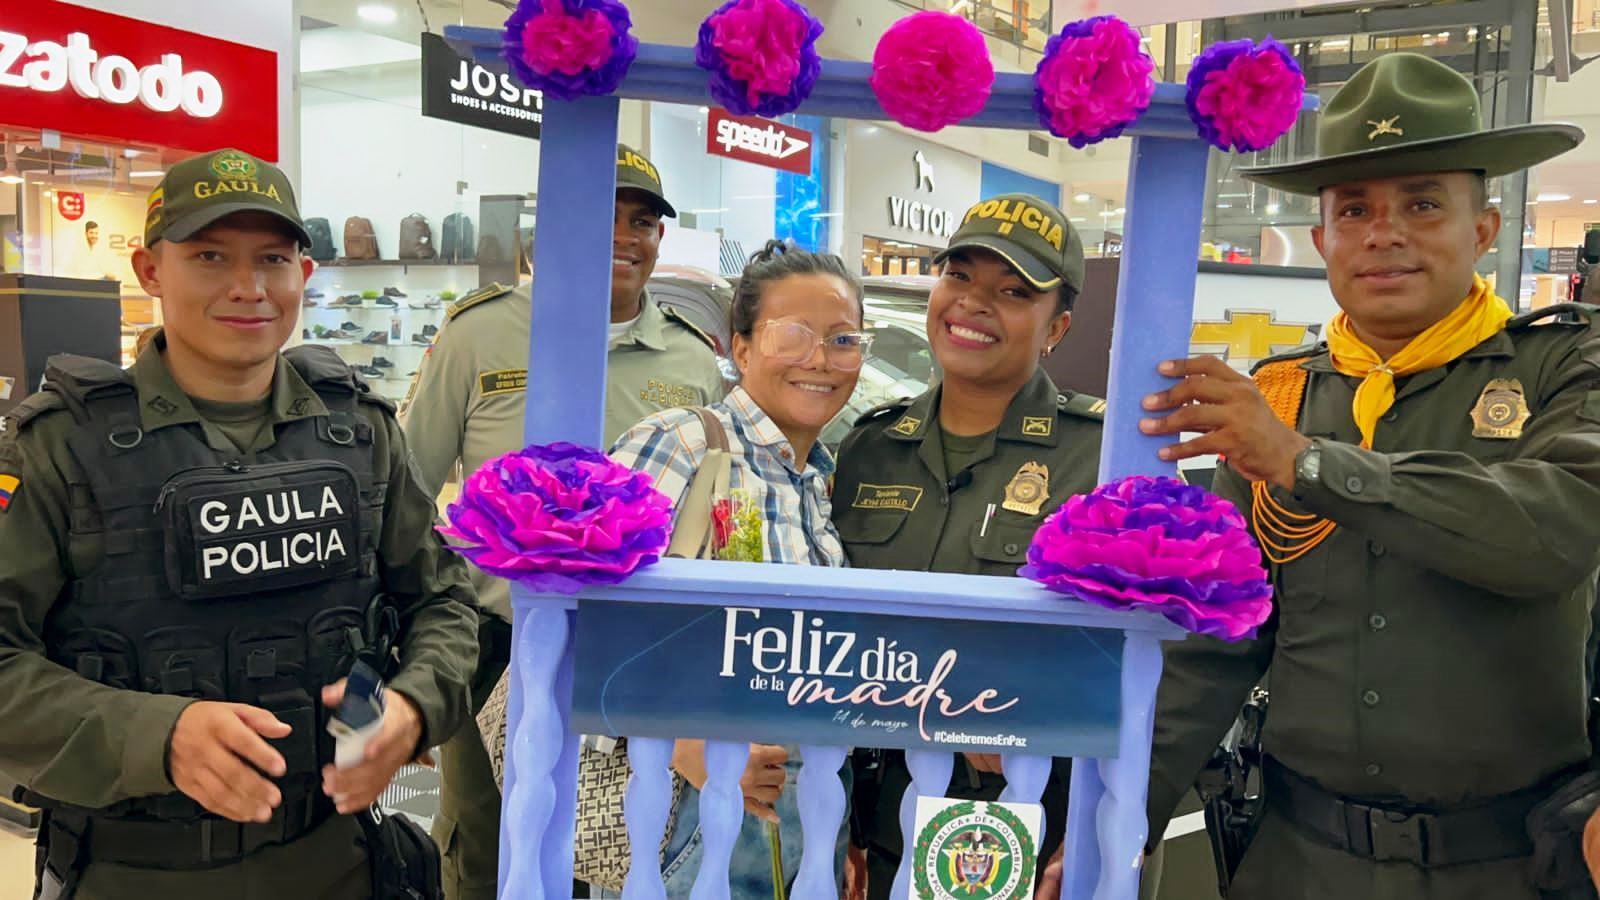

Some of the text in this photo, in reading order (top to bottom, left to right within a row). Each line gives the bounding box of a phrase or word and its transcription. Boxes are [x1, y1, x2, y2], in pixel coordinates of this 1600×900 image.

[451, 93, 480, 109] SHOES
[481, 100, 488, 110] &
[716, 119, 786, 158] speedo
[194, 181, 282, 204] GAULA
[888, 195, 954, 238] VICTOR
[965, 199, 1063, 251] POLICIA
[200, 485, 344, 533] GAULA
[202, 528, 346, 579] POLICIA
[720, 607, 922, 683] Feliz día
[750, 649, 1019, 741] de la madre
[851, 713, 866, 728] de
[872, 719, 909, 733] mayo
[934, 731, 1027, 747] #CelebremosEnPaz
[996, 822, 1020, 873] COLOMBIA
